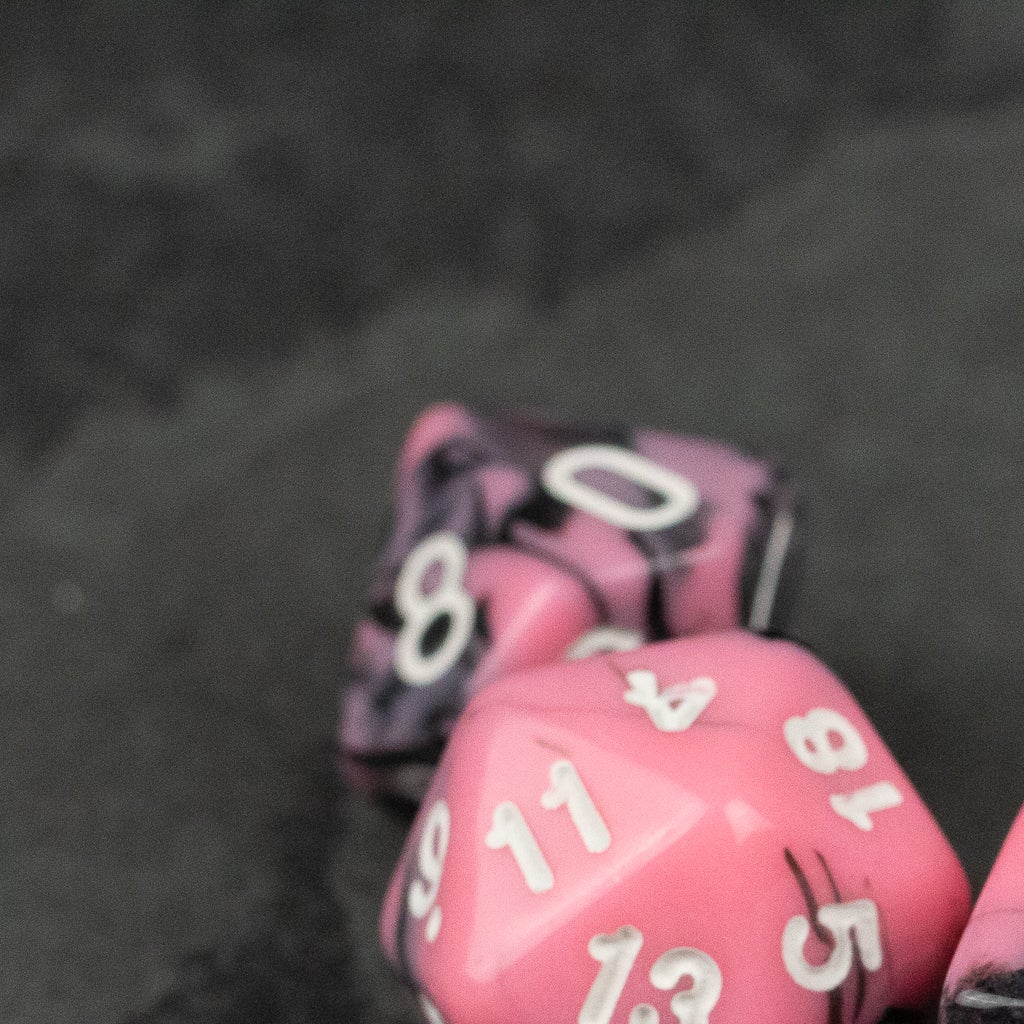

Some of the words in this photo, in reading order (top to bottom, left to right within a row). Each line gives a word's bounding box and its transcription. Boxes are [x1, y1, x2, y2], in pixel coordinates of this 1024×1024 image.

[542, 441, 699, 533] 0
[395, 531, 476, 686] 8
[624, 669, 717, 733] 4
[783, 708, 904, 831] 18
[485, 759, 611, 893] 11
[781, 898, 883, 993] 5
